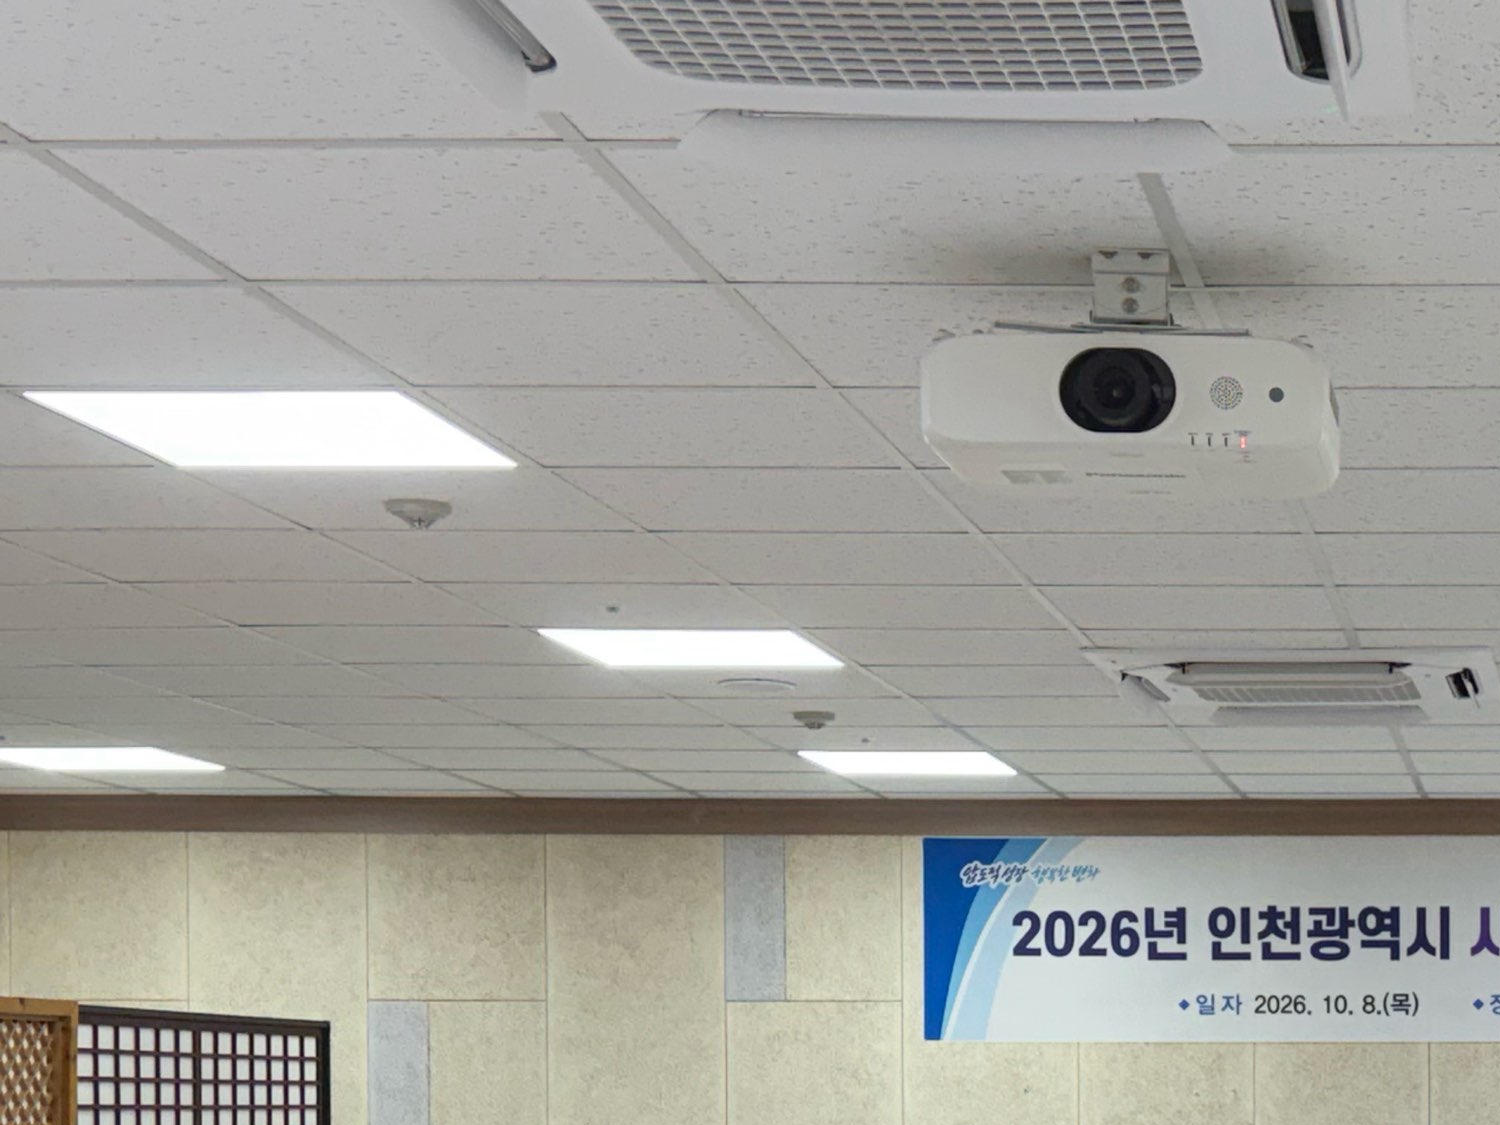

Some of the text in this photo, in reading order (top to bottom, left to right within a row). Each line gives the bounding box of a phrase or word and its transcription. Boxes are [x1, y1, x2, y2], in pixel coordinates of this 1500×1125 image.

[1011, 906, 1188, 960] 2026년
[1207, 905, 1451, 960] 인천광역시
[1196, 991, 1419, 1017] 일자 2026. 10. 8.(목)
